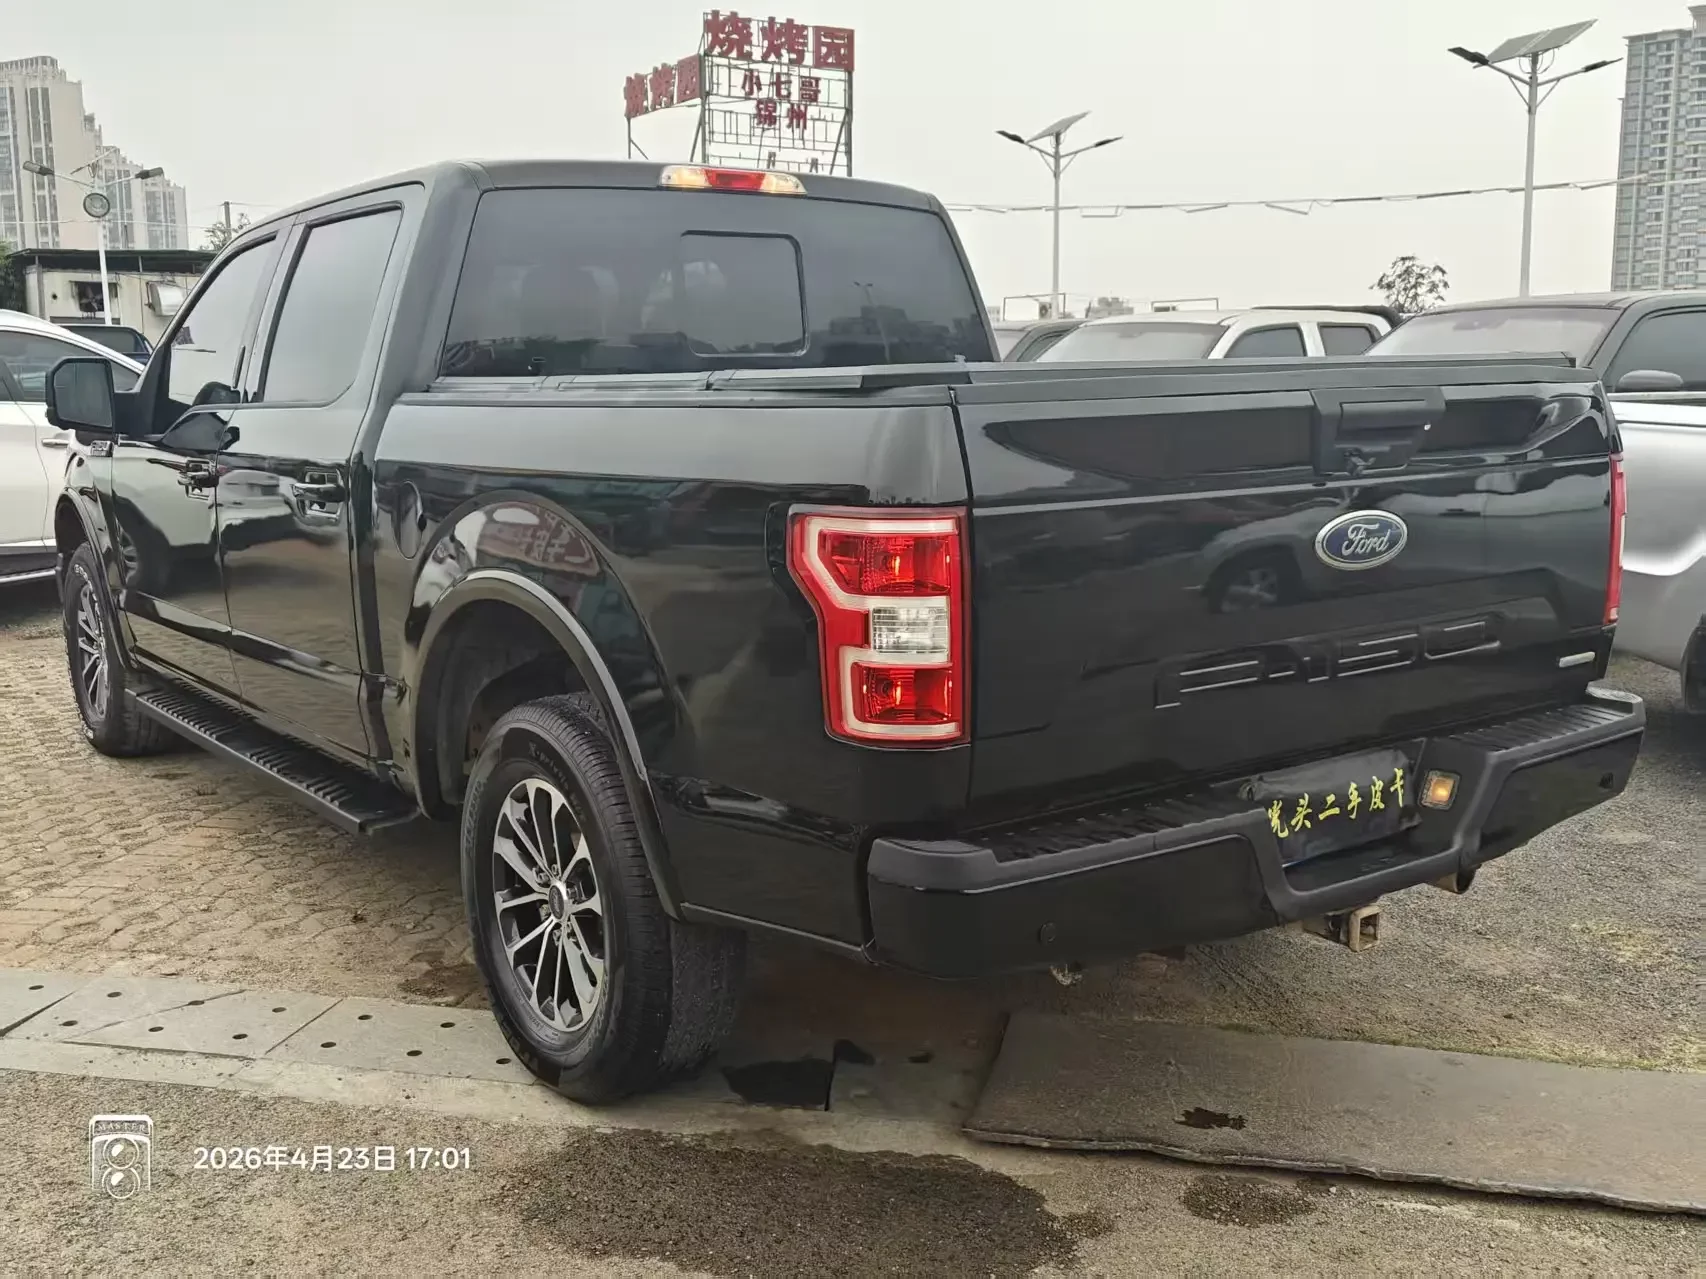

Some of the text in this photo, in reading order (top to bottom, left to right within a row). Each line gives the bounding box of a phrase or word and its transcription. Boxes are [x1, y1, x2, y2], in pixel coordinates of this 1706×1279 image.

[704, 10, 854, 71] 烧烤园
[741, 69, 821, 103] 小七哥
[1341, 523, 1391, 556] Ford
